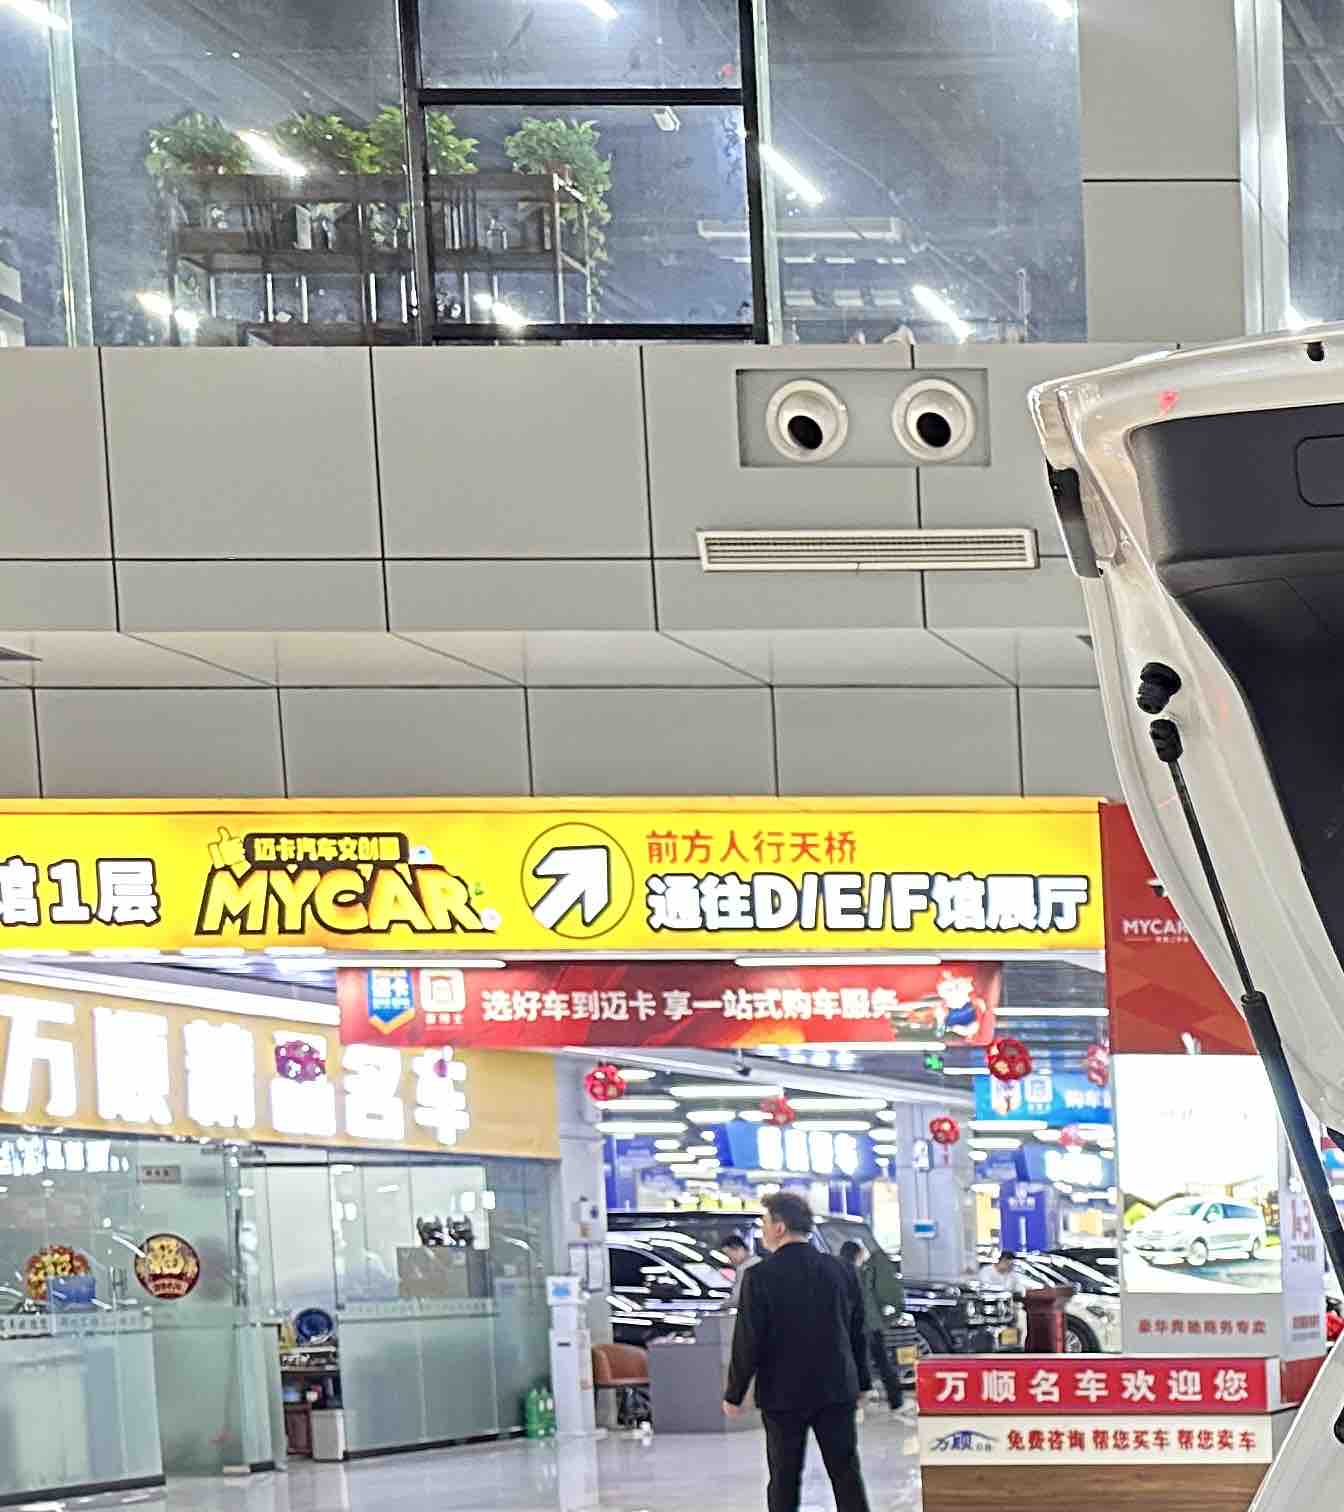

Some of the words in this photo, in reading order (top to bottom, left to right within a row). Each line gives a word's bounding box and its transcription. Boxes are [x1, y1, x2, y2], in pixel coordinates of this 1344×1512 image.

[645, 829, 857, 865] 前方人行天桥
[194, 864, 496, 936] MYCAR
[643, 871, 1091, 933] 通往D/E/F馆展厅
[481, 989, 657, 1022] 选好车到迈卡
[661, 987, 900, 1020] 享一站式购车服务
[935, 1369, 1251, 1404] 万顺名车欢迎您
[1007, 1428, 1086, 1452] 免费咨询
[1092, 1428, 1171, 1452] 帮您买车
[1177, 1428, 1258, 1452] 帮您卖车
